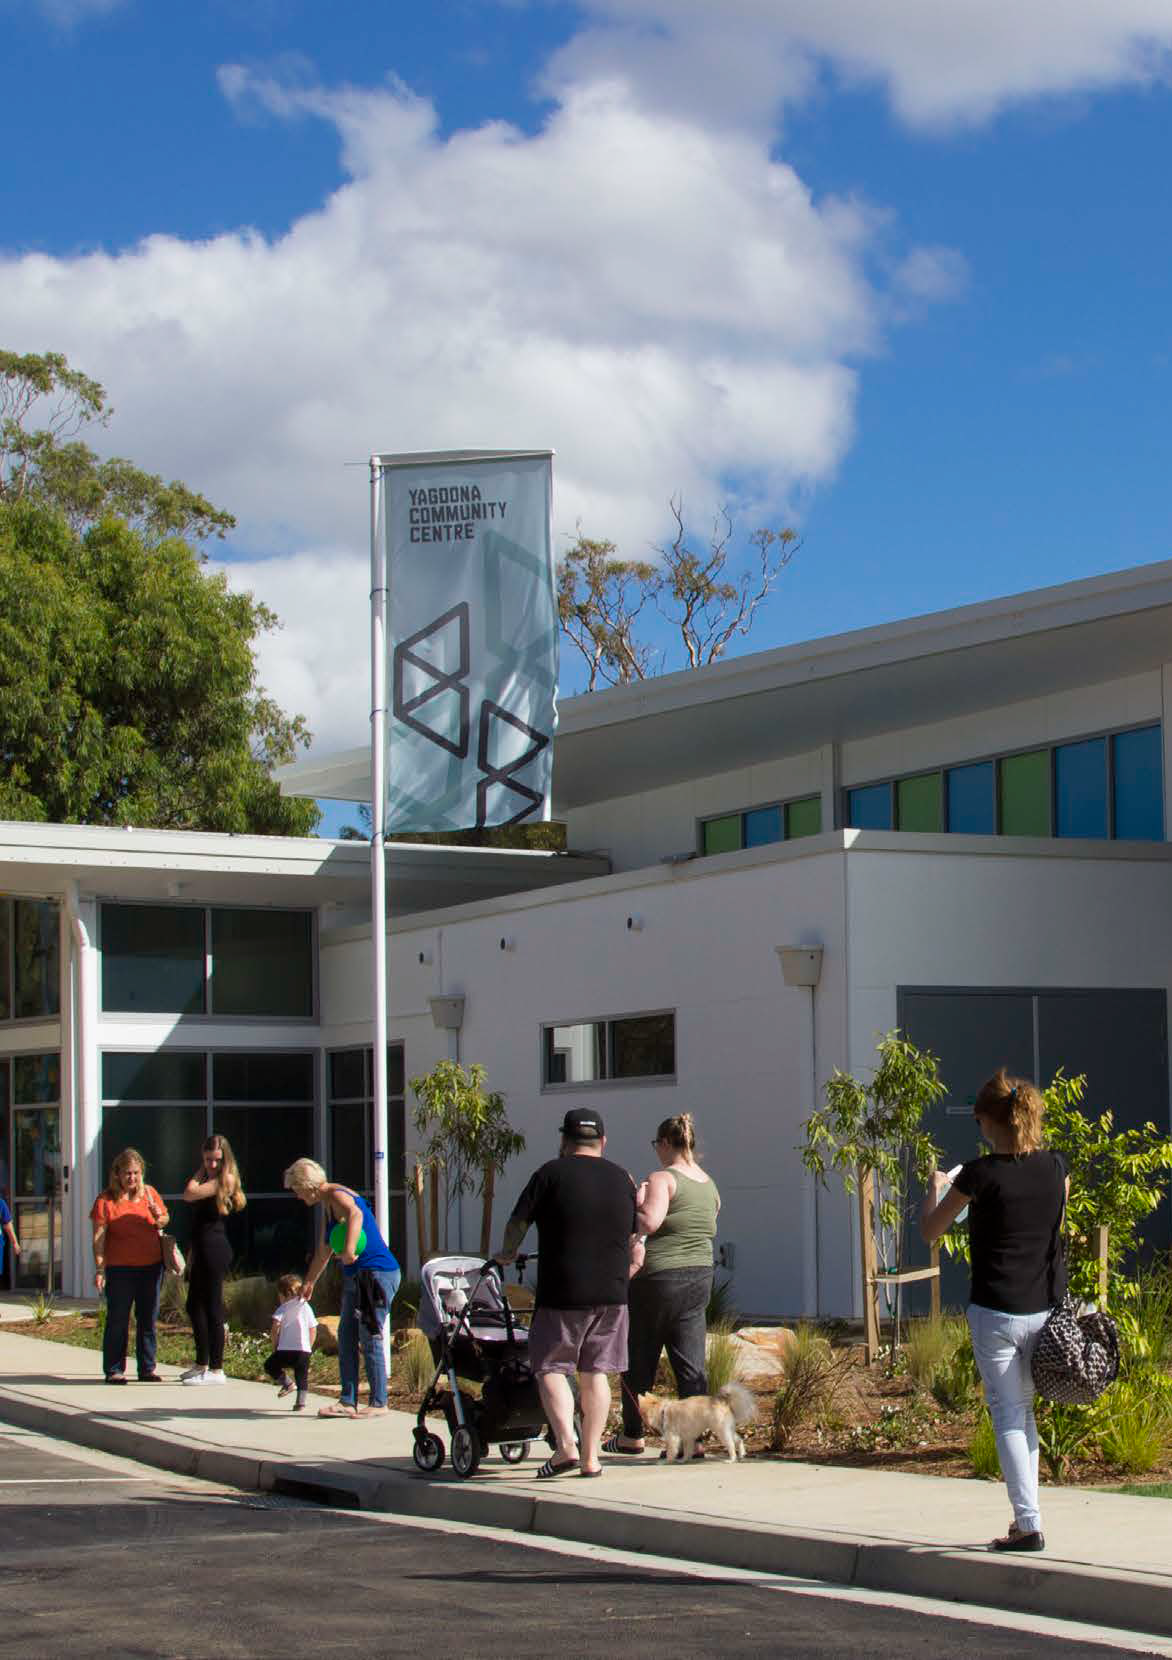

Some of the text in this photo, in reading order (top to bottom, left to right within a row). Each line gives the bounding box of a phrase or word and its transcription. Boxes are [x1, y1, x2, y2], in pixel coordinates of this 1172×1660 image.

[409, 486, 481, 506] YAGOONA
[409, 502, 507, 524] COMMUNITY
[410, 523, 475, 543] CENTRE
